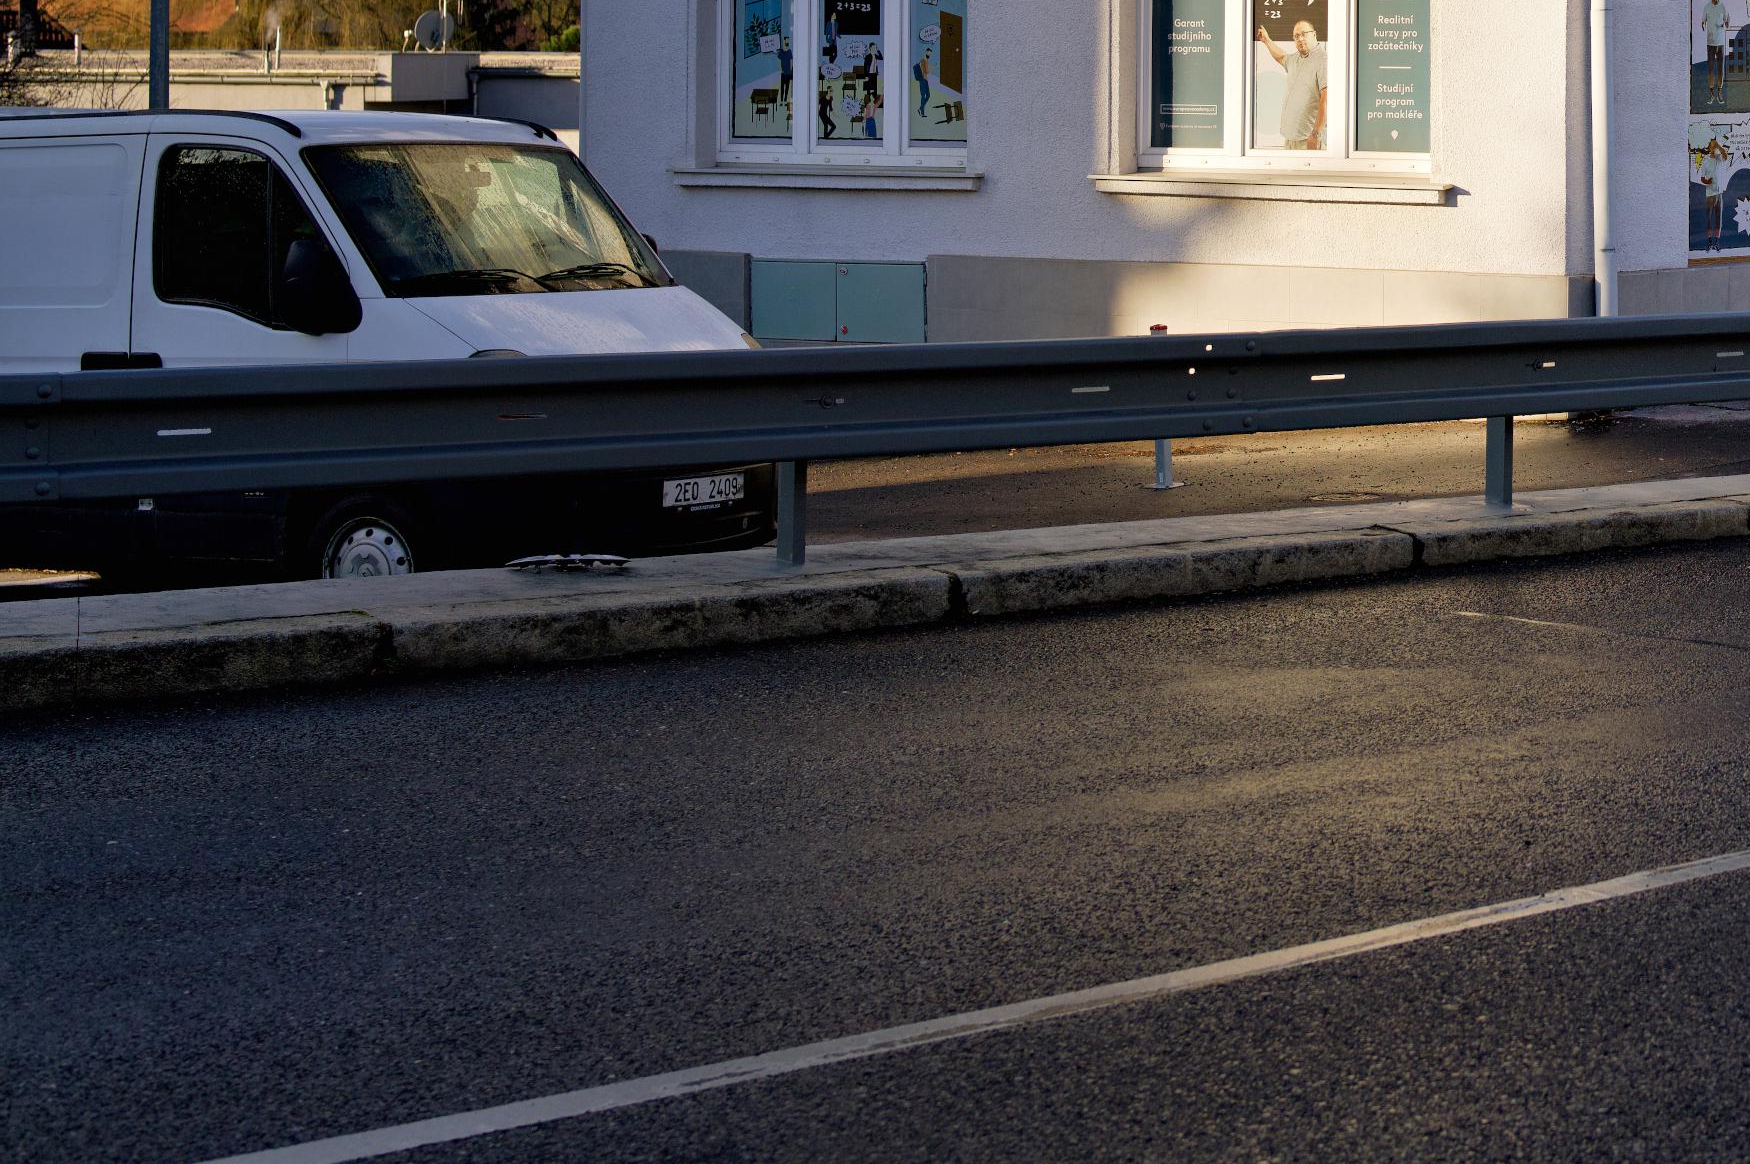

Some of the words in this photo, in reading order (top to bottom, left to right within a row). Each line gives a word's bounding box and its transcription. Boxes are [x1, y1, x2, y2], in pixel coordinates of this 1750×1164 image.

[1174, 18, 1204, 28] Garant
[1378, 15, 1413, 24] Realitní
[1167, 31, 1212, 43] studijního
[1373, 28, 1399, 39] kurzy
[1402, 29, 1418, 39] pro
[1168, 44, 1211, 55] programu
[1367, 41, 1423, 53] začátečníky
[1377, 83, 1413, 95] Studijní
[1375, 98, 1415, 108] program
[1367, 111, 1383, 121] pro
[1385, 109, 1423, 119] makléře
[708, 476, 738, 499] 2409
